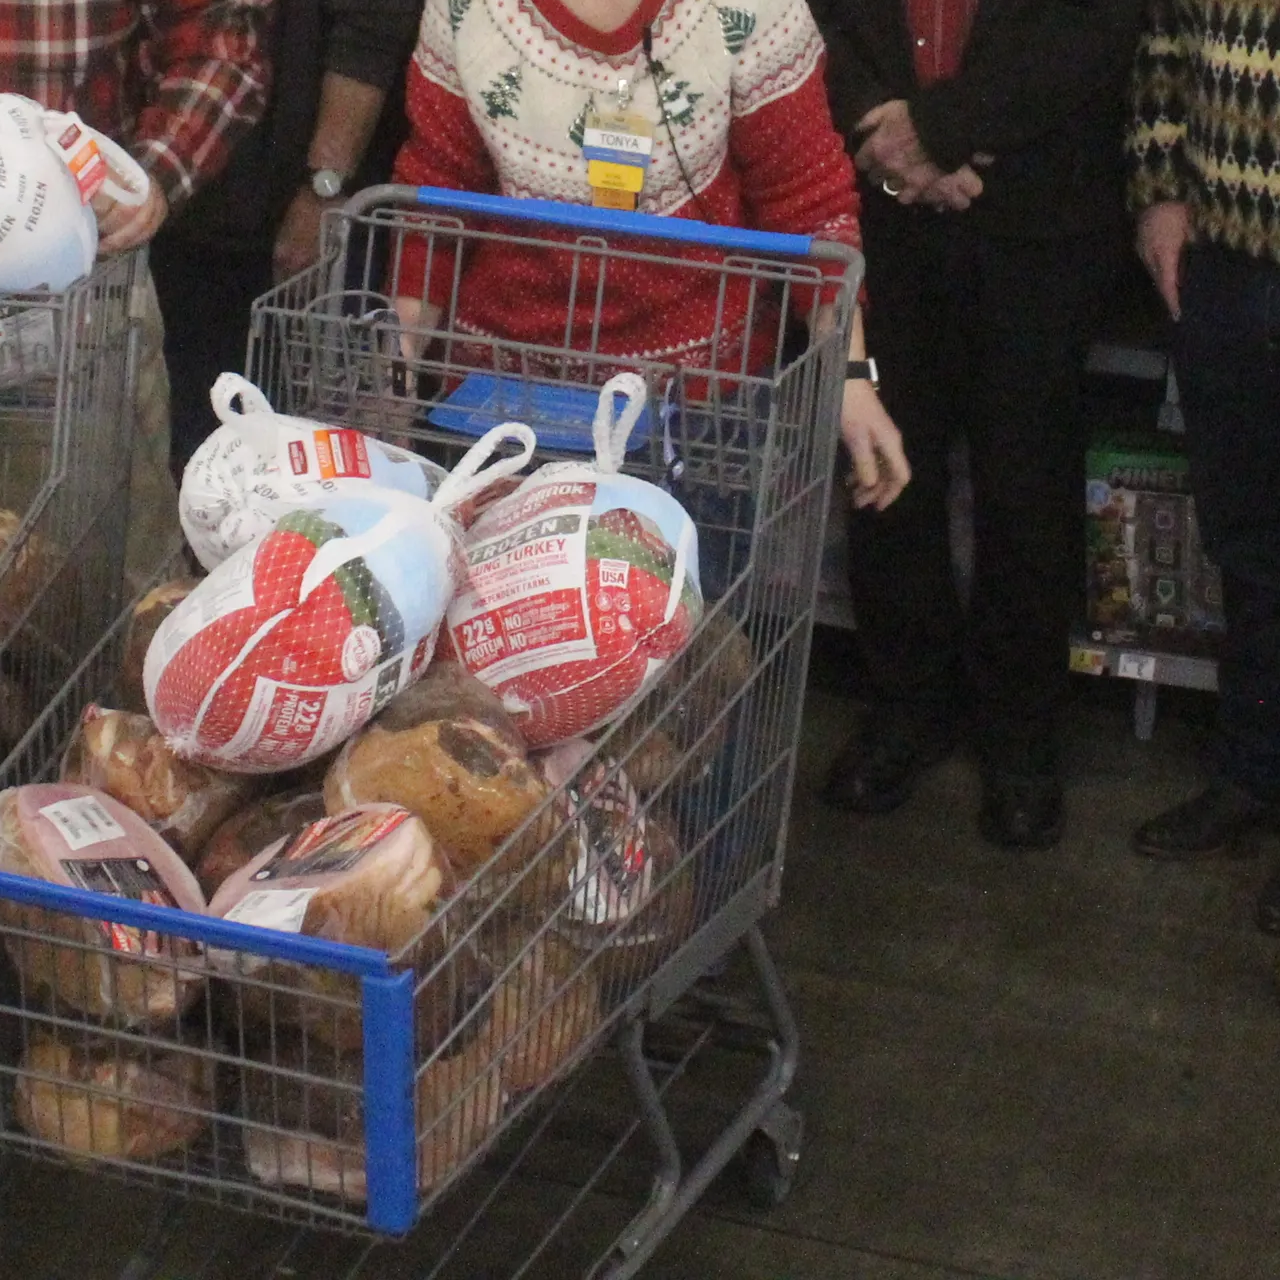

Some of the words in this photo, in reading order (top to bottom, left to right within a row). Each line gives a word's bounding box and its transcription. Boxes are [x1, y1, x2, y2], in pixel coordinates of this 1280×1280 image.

[600, 133, 639, 149] TONYA
[25, 181, 48, 233] FROZEN
[471, 519, 559, 564] FROZEN
[505, 538, 567, 565] TURKEY
[522, 576, 551, 592] FARMS
[601, 570, 625, 586] USA
[461, 616, 495, 647] 22g
[504, 614, 522, 631] NO
[465, 635, 506, 663] PROTEIN
[509, 632, 527, 649] NO
[273, 692, 298, 737] PROTEIN
[294, 699, 321, 734] 22g
